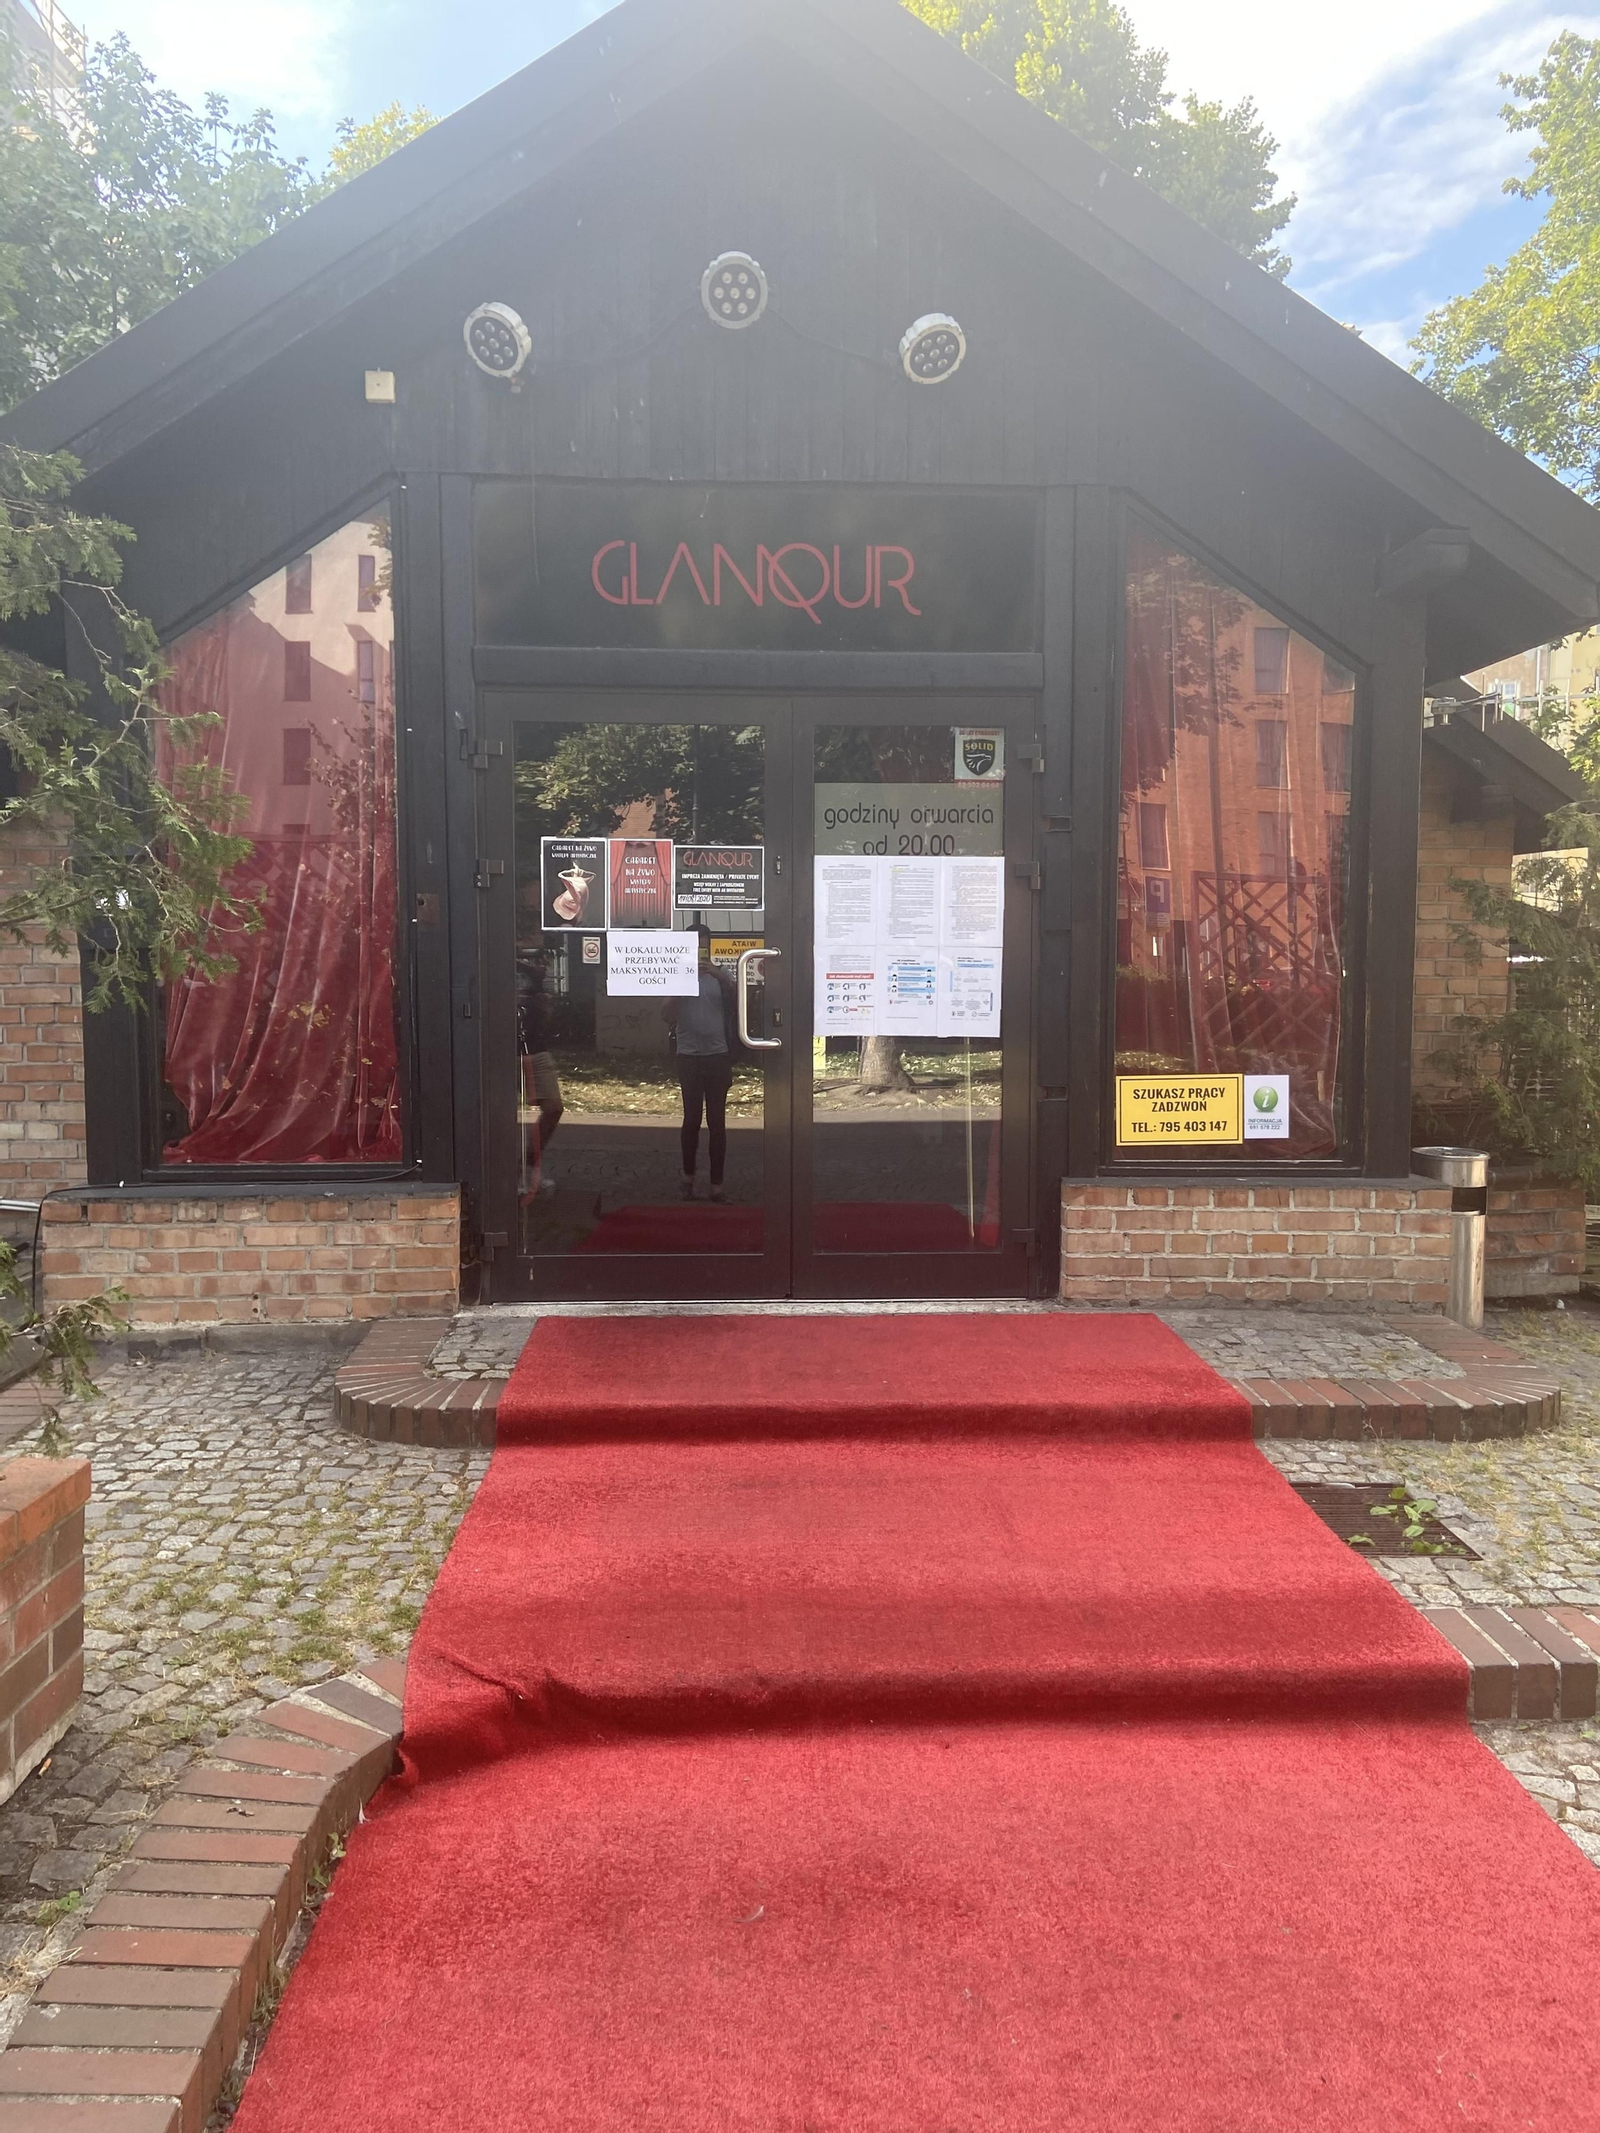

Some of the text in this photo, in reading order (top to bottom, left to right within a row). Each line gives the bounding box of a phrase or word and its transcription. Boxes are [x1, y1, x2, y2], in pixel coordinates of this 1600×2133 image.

[964, 742, 994, 751] SOLID
[824, 802, 994, 830] godziny otwarcia
[862, 834, 955, 856] od 20.00
[625, 856, 656, 865] CABARET
[625, 867, 656, 876] NA ŻYWO
[614, 945, 690, 954] W LOKALU MOŻE
[625, 955, 680, 964] PRZEBYWAĆ
[685, 966, 695, 975] 36
[638, 975, 666, 984] GOŚCI
[1133, 1087, 1226, 1099] SZUKASZ PRACY
[1151, 1097, 1207, 1112] ZADZWOŃ
[1131, 1120, 1228, 1133] TEL.: 795 403 147
